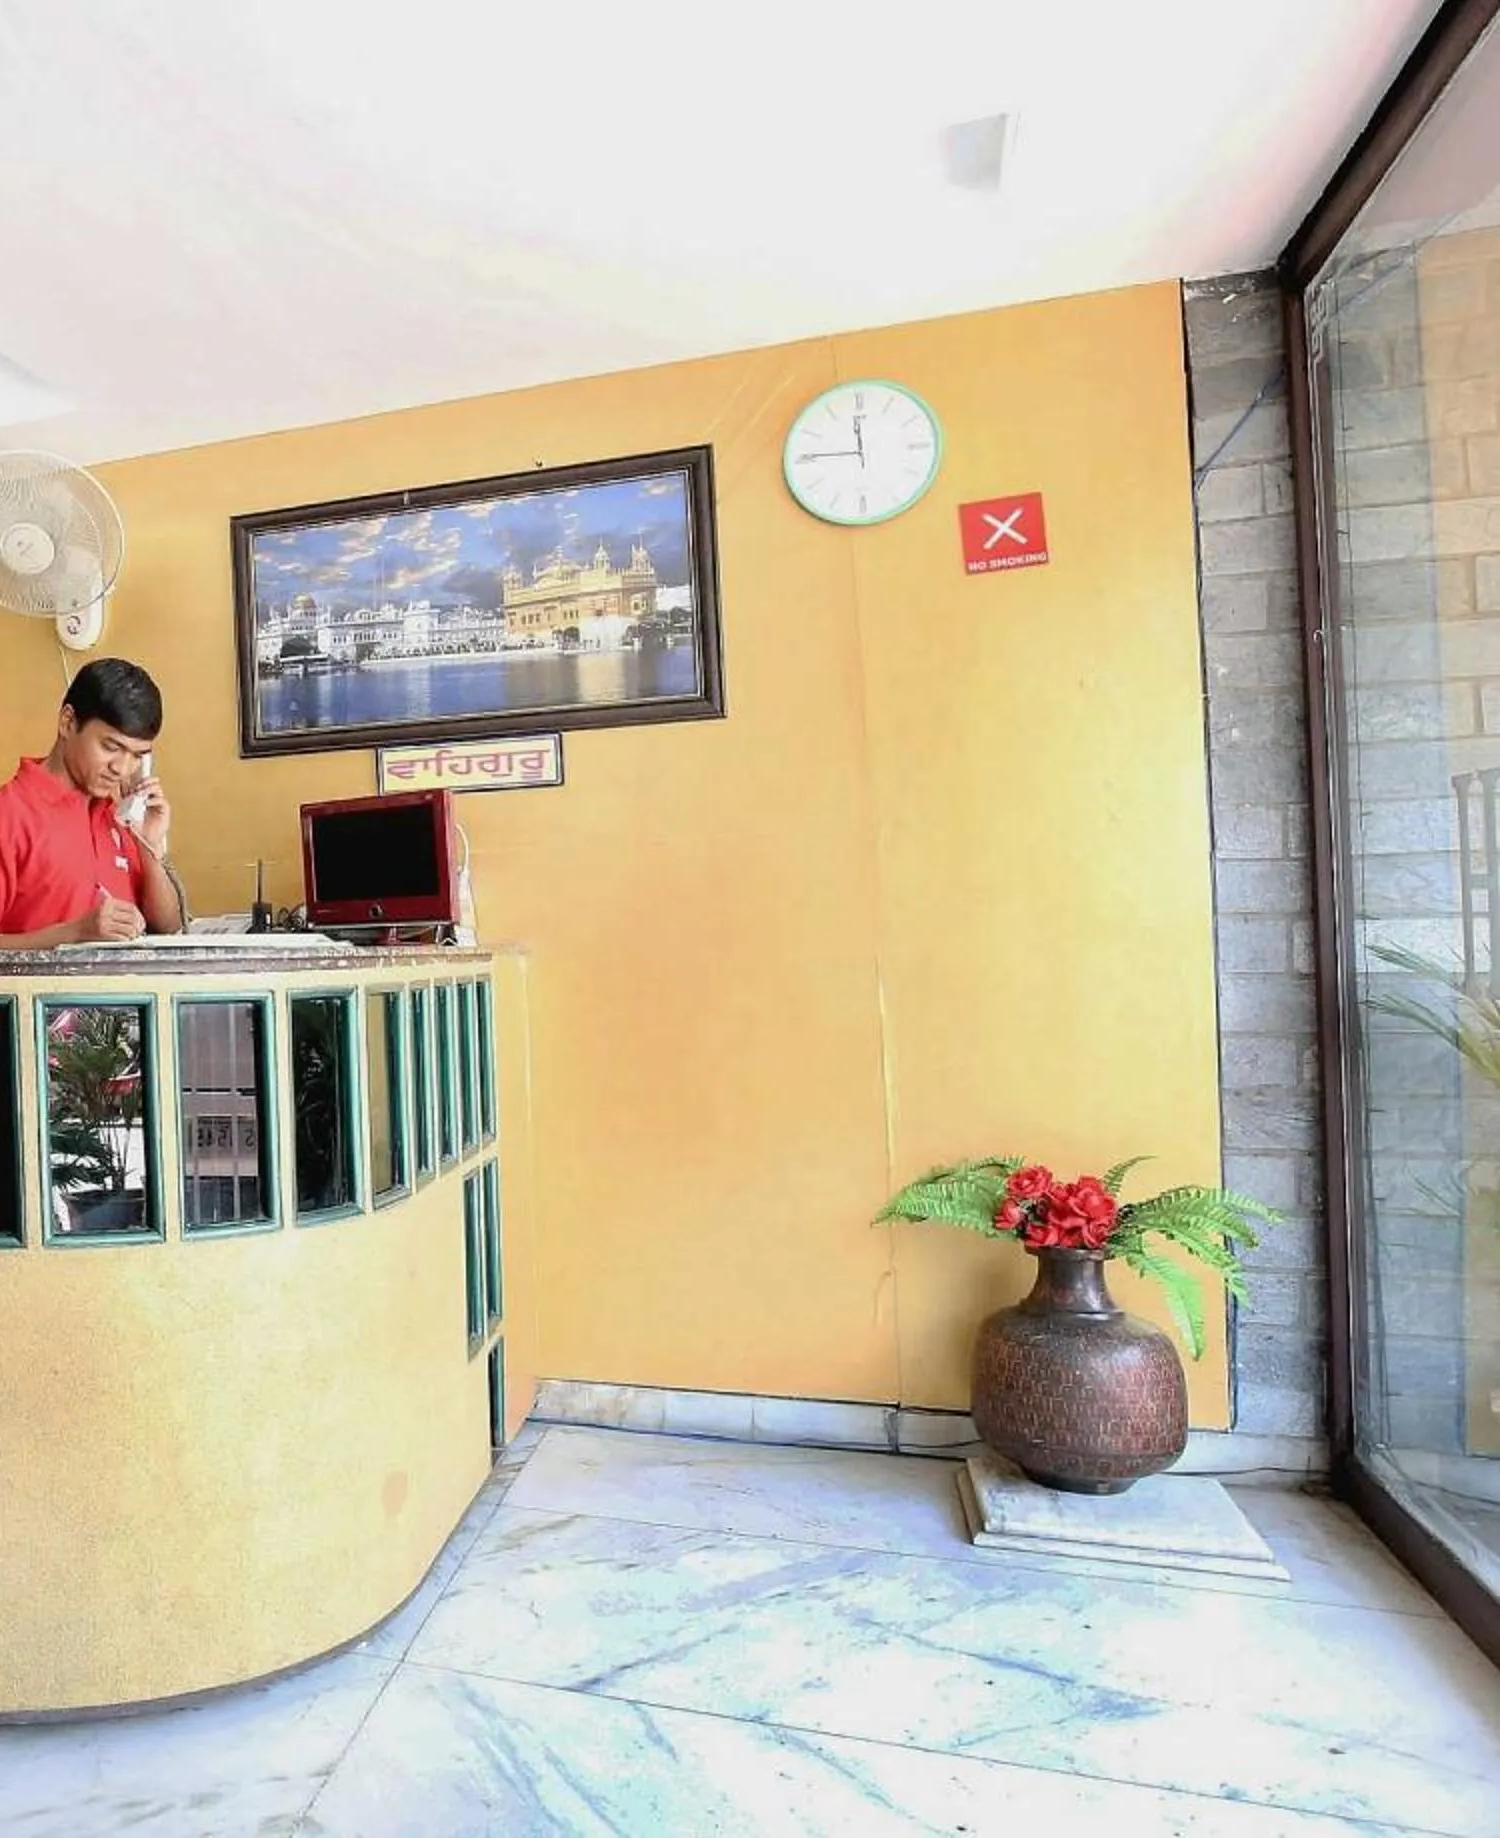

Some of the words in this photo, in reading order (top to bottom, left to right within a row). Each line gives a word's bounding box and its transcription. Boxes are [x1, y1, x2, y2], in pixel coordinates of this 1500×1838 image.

[967, 560, 987, 572] NO
[989, 552, 1047, 570] SMOKING
[387, 749, 549, 780] ਵਾਹਿਗੁਰੂ
